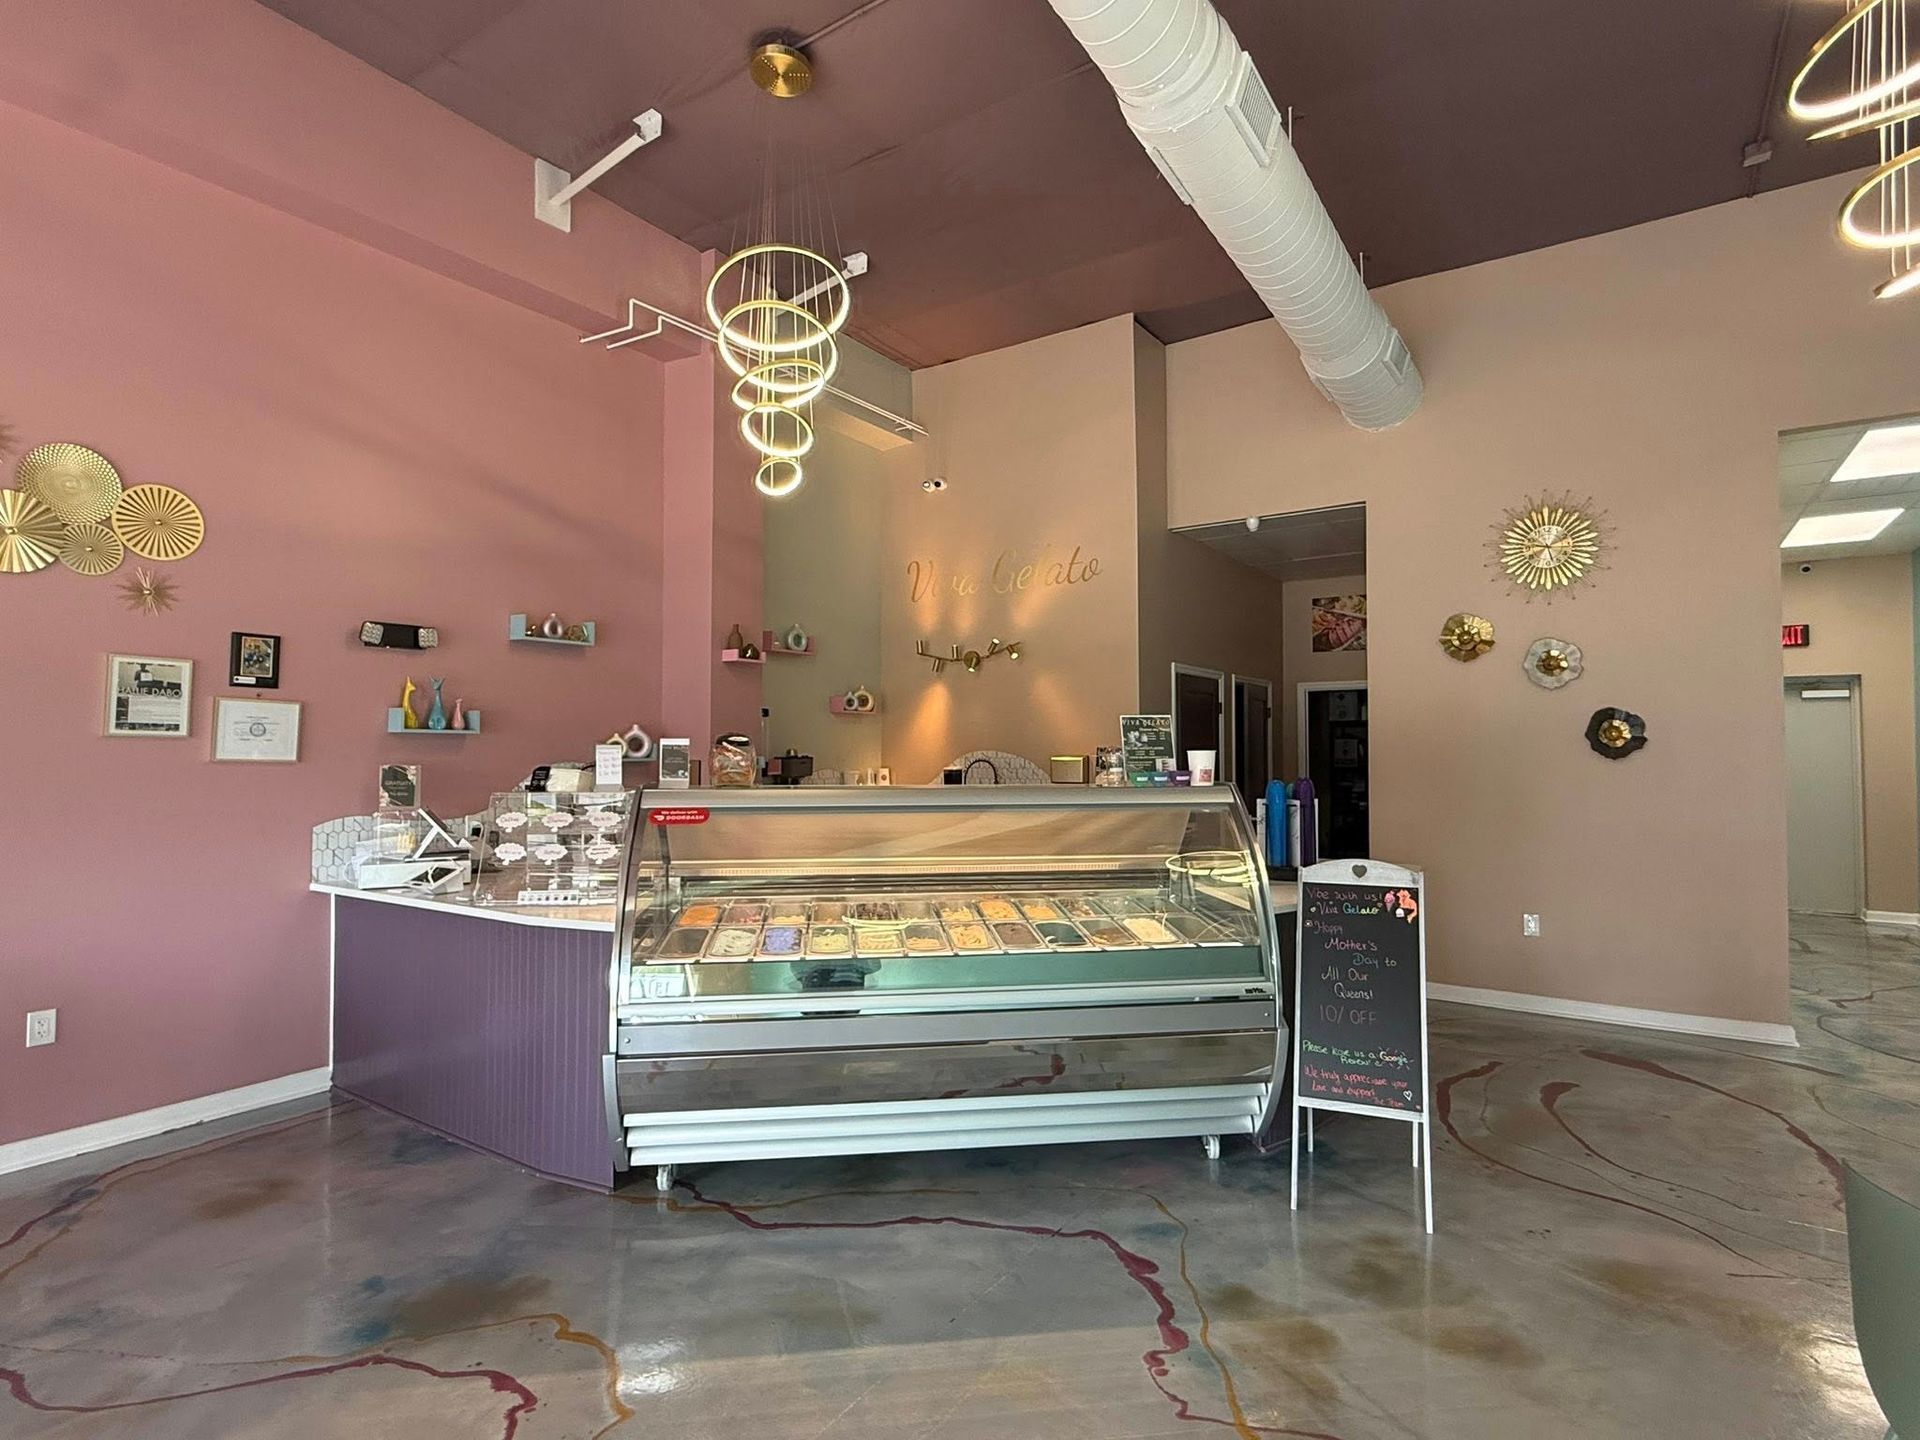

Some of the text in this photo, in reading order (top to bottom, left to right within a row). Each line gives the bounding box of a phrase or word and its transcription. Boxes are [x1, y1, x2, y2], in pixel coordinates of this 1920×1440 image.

[907, 560, 978, 603] Via
[1782, 626, 1804, 644] XIT
[1122, 718, 1141, 727] VIVA
[1343, 902, 1380, 915] Gelato
[1325, 938, 1378, 952] Mother's
[1352, 952, 1397, 969] Day to
[1321, 966, 1369, 981] All Our
[1349, 1009, 1377, 1025] OFF
[1302, 1039, 1328, 1055] Please
[1379, 1051, 1408, 1066] Google
